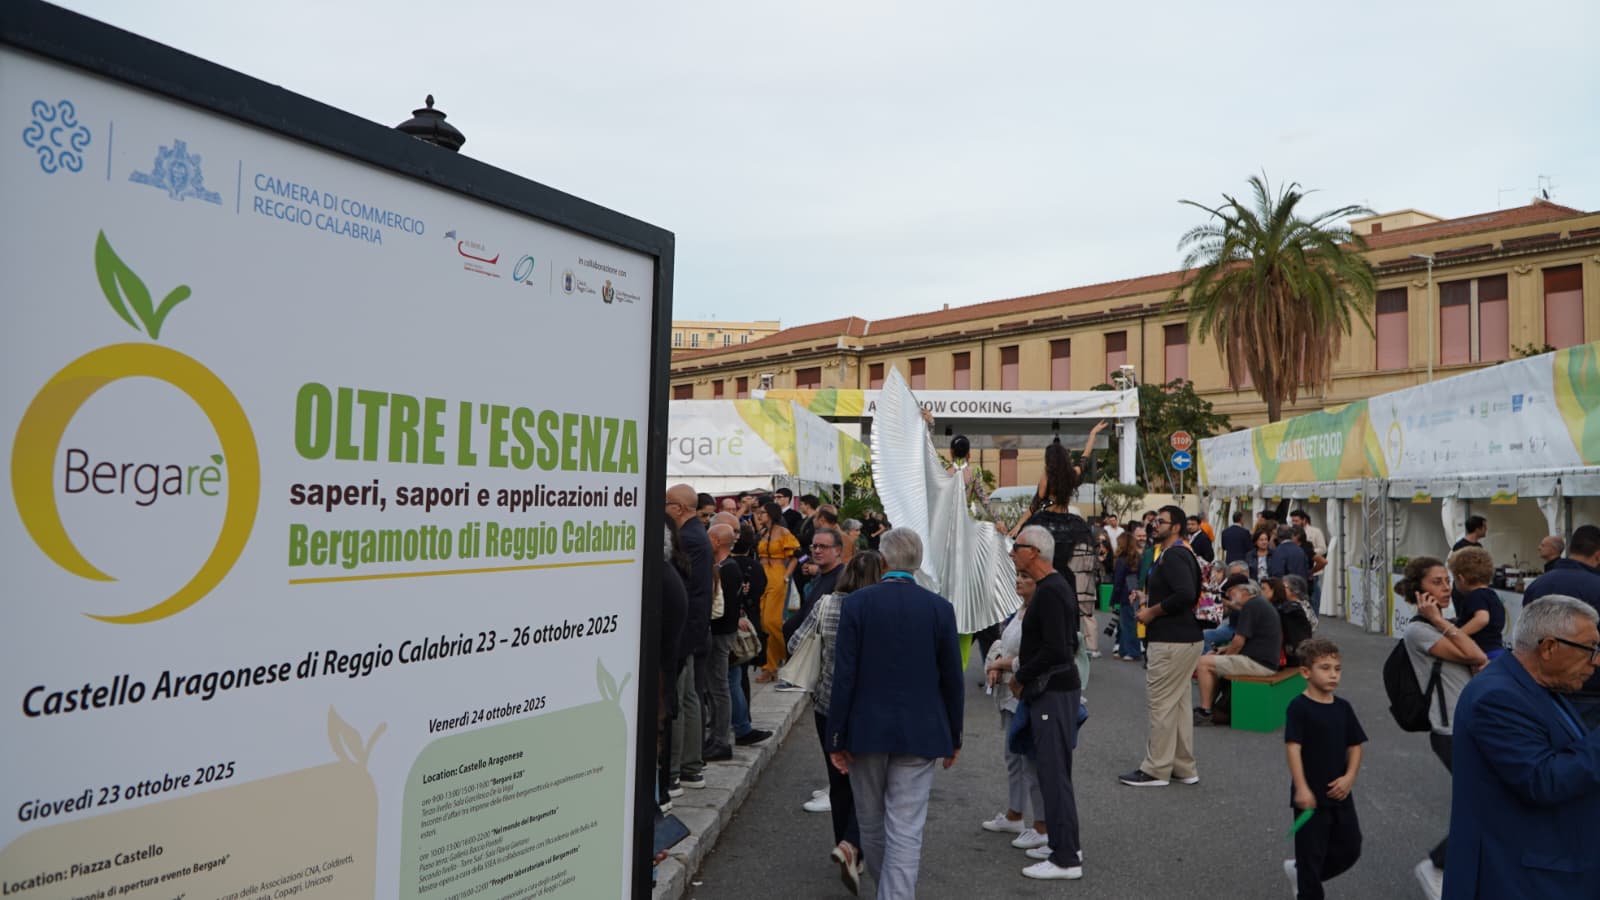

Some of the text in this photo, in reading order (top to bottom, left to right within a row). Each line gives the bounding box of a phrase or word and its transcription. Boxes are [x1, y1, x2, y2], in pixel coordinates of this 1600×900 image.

[254, 173, 425, 236] CAMERA DI COMMERCIO
[254, 196, 383, 245] REGGIO CALABRIA
[950, 400, 1012, 414] COOKING
[294, 382, 639, 475] OLTRE L'ESSENZA
[1173, 436, 1189, 445] STOP
[1319, 432, 1342, 457] FOOD
[668, 430, 744, 464] rgarè
[64, 448, 224, 506] Bergarè
[290, 480, 638, 512] saperi, sapori e applicazioni del
[289, 520, 637, 570] Bergamotto di Reggio Calabria
[22, 675, 146, 718] Castello
[152, 661, 291, 702] Aragonese
[296, 651, 318, 679] di
[323, 645, 394, 681] Reggio
[399, 635, 473, 665] Calabria
[476, 632, 497, 654] 23
[511, 625, 530, 648] 26
[533, 619, 585, 644] ottobre
[587, 614, 618, 638] 2025
[429, 696, 546, 734] Venerdì 24 ottobre 2025
[422, 750, 524, 785] Location: Castello Aragonese
[18, 761, 235, 822] Giovedì 23 ottobre 2025
[2, 844, 164, 897] Location: Piazza Castello
[107, 883, 117, 897] di
[118, 876, 159, 895] apertura
[160, 867, 191, 882] evento
[240, 885, 259, 898] delle
[260, 871, 304, 891] Associazioni
[304, 873, 333, 888] Unicoop
